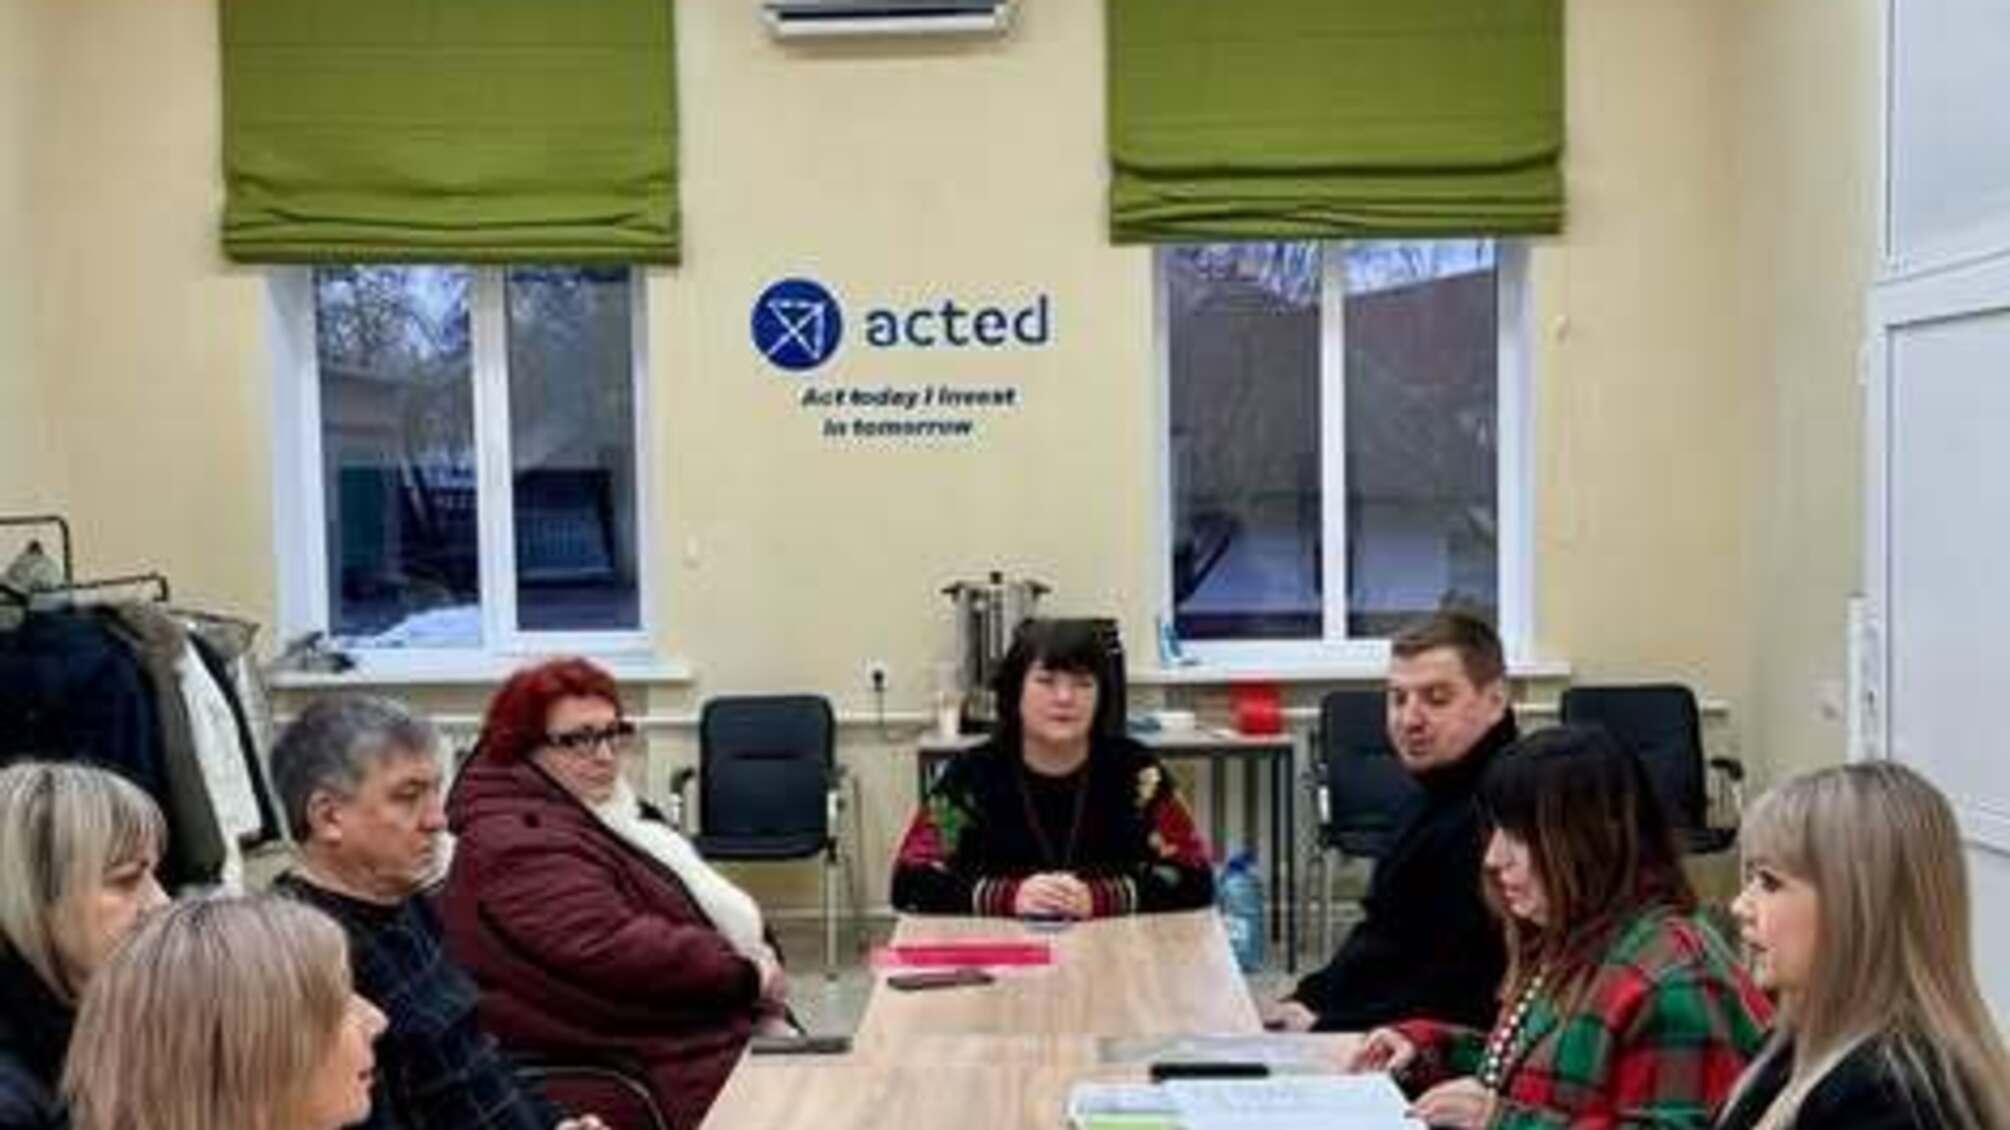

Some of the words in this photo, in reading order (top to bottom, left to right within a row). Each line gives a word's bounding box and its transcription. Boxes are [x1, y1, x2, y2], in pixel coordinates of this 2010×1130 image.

[865, 294, 1049, 347] acted
[802, 386, 846, 406] Act
[850, 386, 919, 410] today
[853, 418, 974, 436] tomorrow
